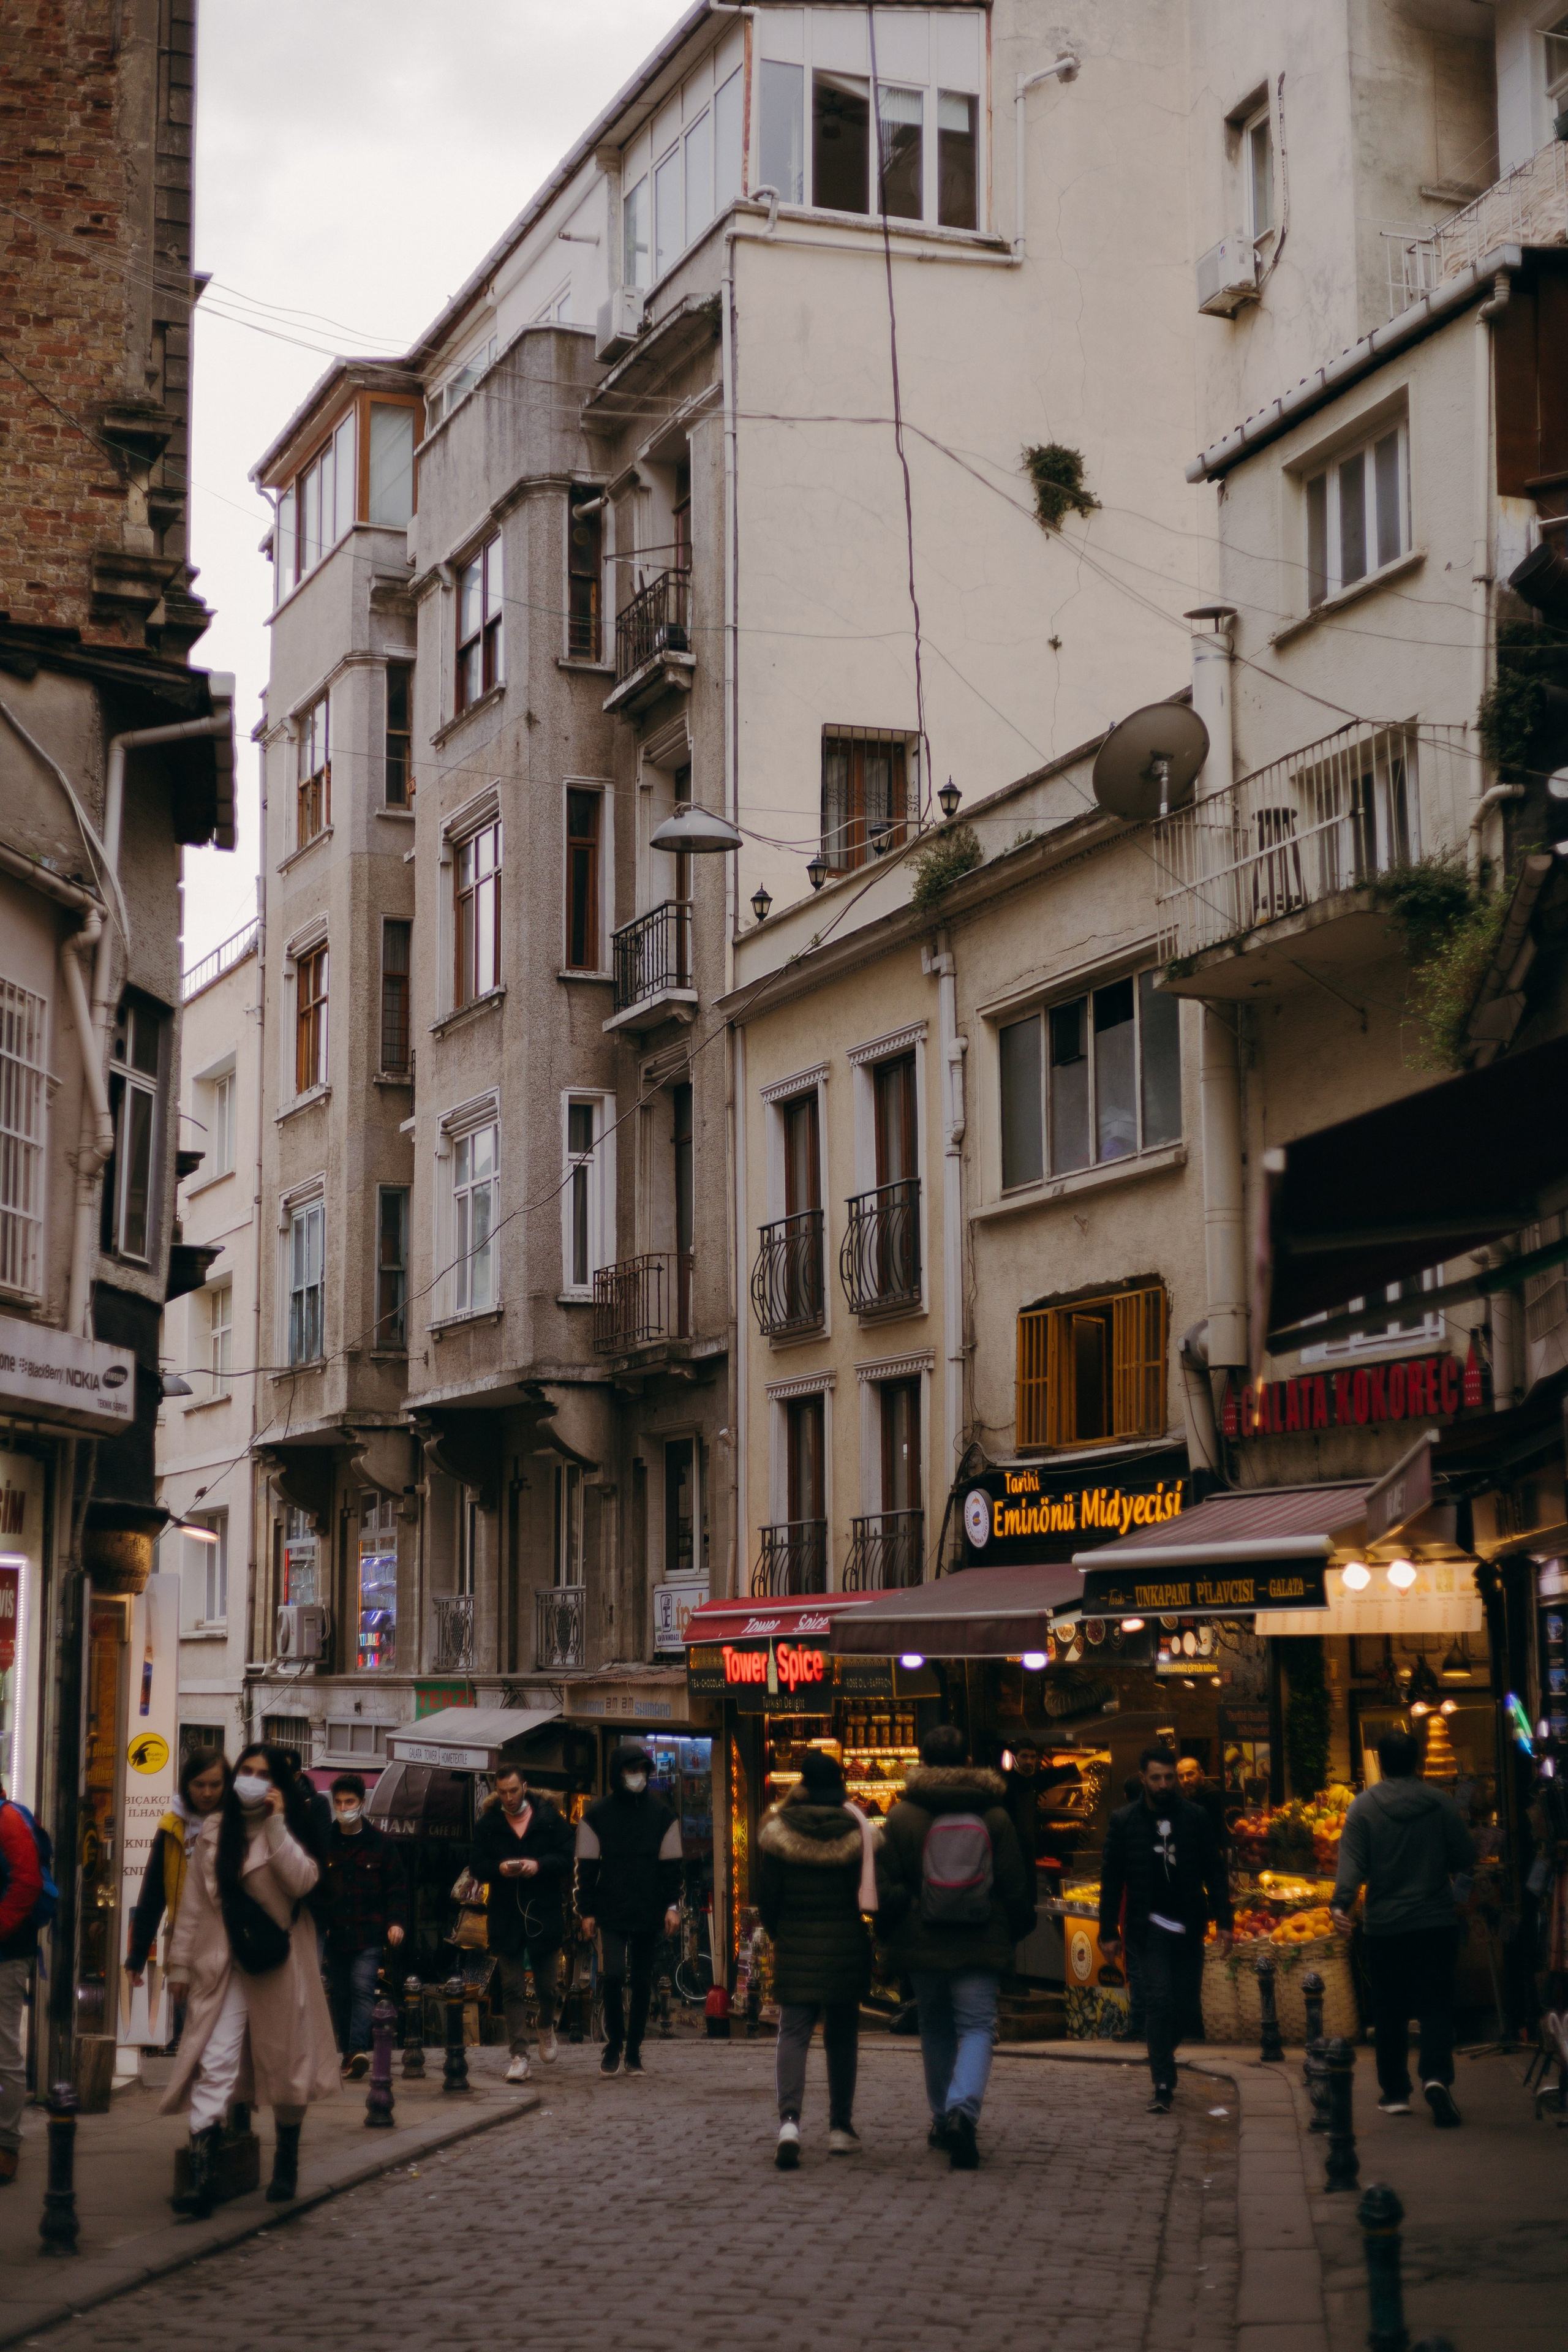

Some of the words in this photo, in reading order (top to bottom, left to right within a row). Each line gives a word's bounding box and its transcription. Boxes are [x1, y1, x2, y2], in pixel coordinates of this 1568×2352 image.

[28, 1361, 64, 1384] BlackBerry
[66, 1367, 100, 1392] NOKIA
[104, 1372, 126, 1382] SAMSUNG
[1241, 1374, 1328, 1437] GALATA
[1005, 1469, 1039, 1494] Tarihi
[993, 1494, 1076, 1537] Eminönü
[1080, 1480, 1182, 1535] Midyecisi
[1134, 1583, 1191, 1607] UNKAPANI
[1268, 1578, 1305, 1597] GALATA
[741, 1616, 780, 1634] Tower
[793, 1612, 829, 1633] Spice
[358, 1632, 380, 1647] YILMAZ
[722, 1646, 767, 1683] Tower
[777, 1643, 823, 1692] Spice
[701, 1678, 725, 1689] CHOCOLATE
[846, 1678, 858, 1688] ROSE
[870, 1678, 891, 1688] SAFFRON
[634, 1702, 671, 1717] SHIMANO
[763, 1696, 782, 1708] Turkish
[784, 1696, 805, 1711] Delight
[409, 1747, 422, 1760] GALATA
[424, 1749, 437, 1762] TOWER
[441, 1752, 467, 1765] HOMETEXTILE
[124, 1796, 170, 1807] BIÇAKÇI
[128, 1806, 165, 1817] İLHAN
